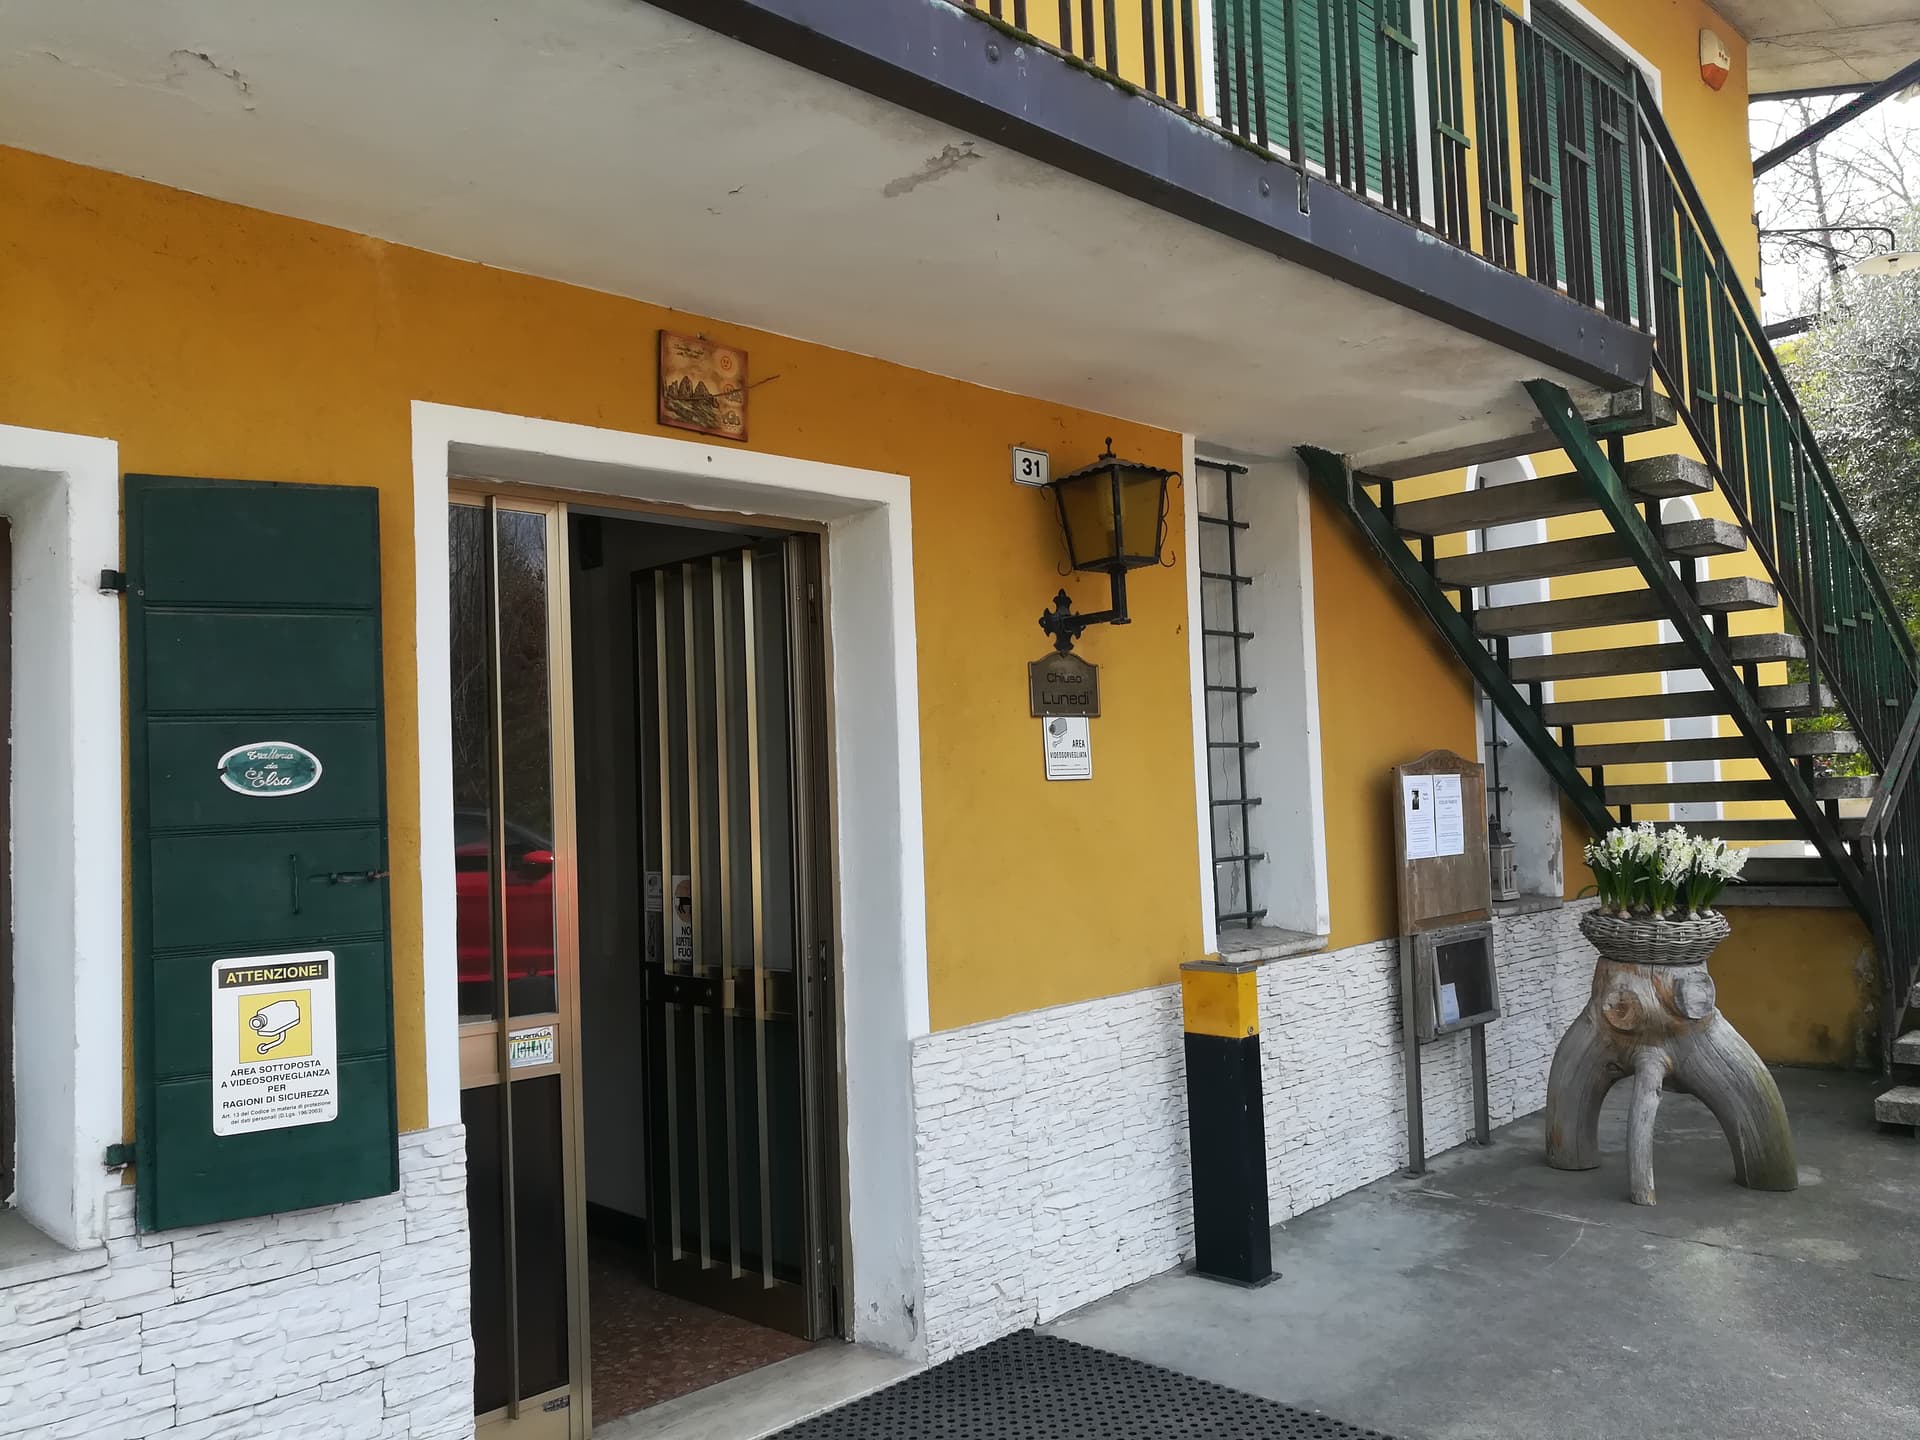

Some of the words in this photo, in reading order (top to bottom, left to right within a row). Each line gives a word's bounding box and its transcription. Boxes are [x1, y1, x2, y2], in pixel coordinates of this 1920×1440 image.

[1022, 457, 1040, 477] 31
[1046, 673, 1082, 683] Chiuso
[1072, 739, 1086, 748] AREA
[245, 768, 292, 788] Elsa
[226, 966, 322, 983] ATTENZIONE!
[231, 1068, 256, 1077] AREA
[259, 1060, 321, 1074] SOTTOPOSTA
[230, 1069, 330, 1087] VIDEOSORVEGLIANZA
[268, 1084, 286, 1093] PER
[223, 1097, 263, 1109] RAGIONI
[266, 1095, 276, 1104] DI
[278, 1089, 330, 1102] SICUREZZA
[303, 1101, 331, 1110] protezione
[252, 1115, 277, 1124] personali
